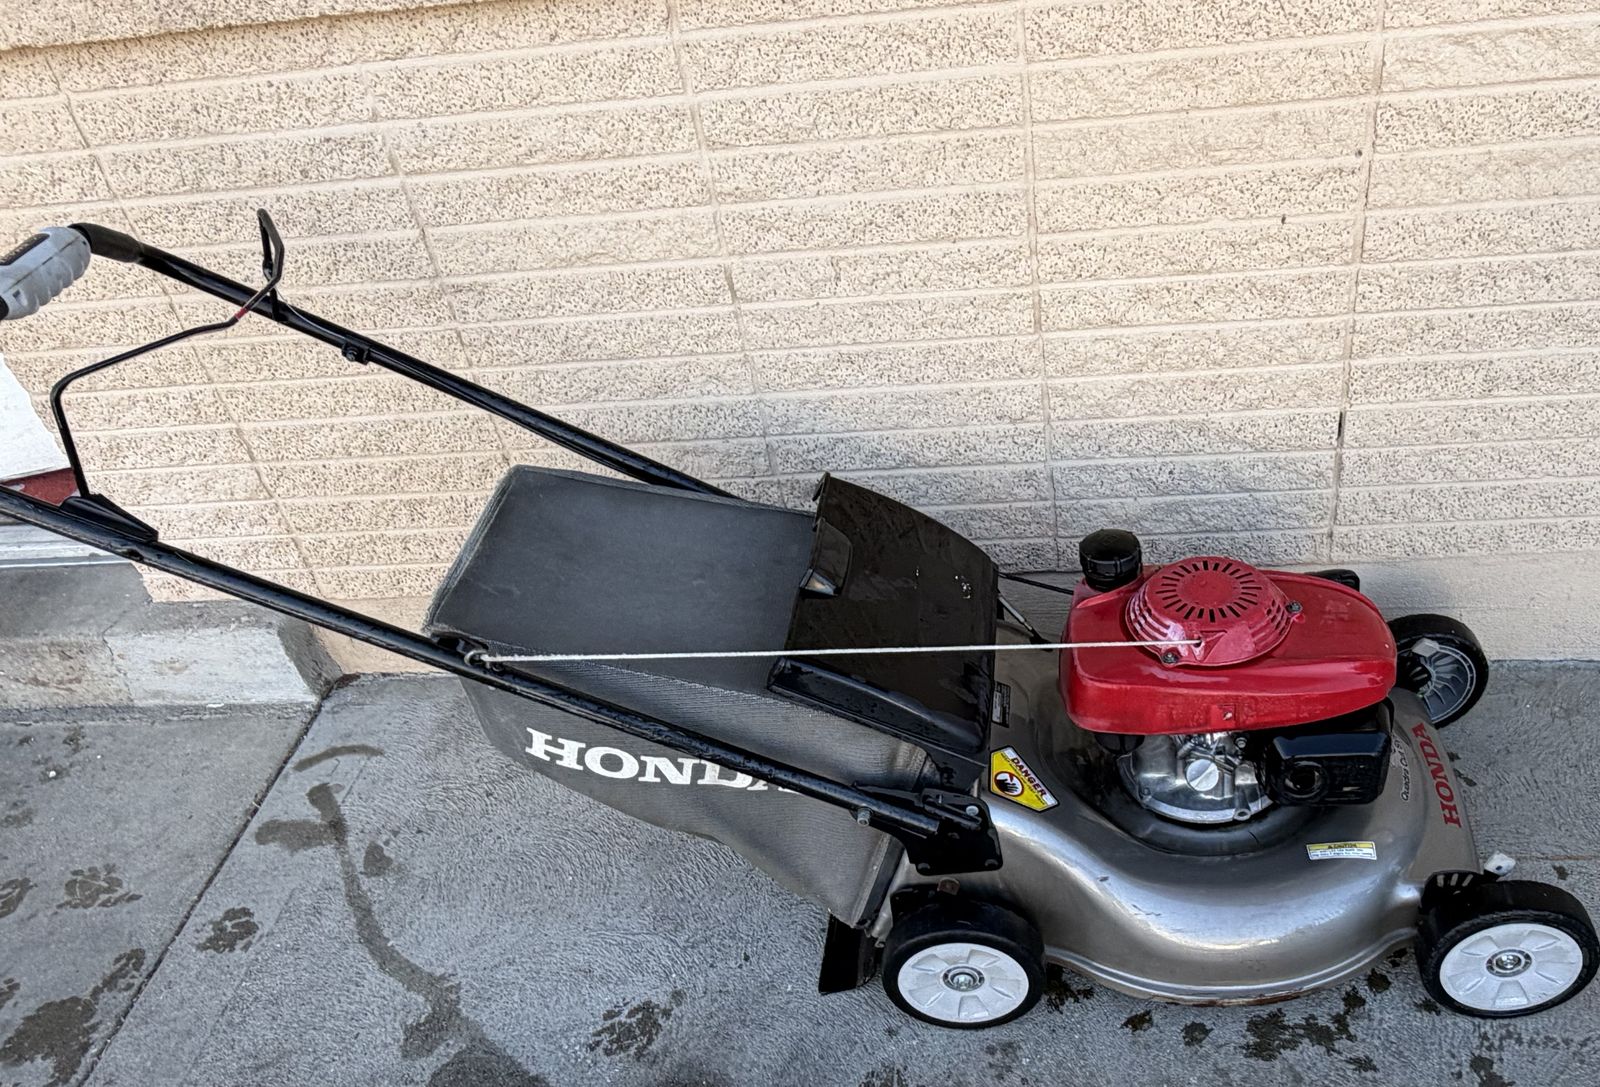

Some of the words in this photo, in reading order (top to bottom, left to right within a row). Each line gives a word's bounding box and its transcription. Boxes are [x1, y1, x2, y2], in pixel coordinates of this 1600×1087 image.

[525, 727, 800, 794] HOND
[1011, 757, 1047, 796] DANGER
[1411, 722, 1461, 828] HONDA
